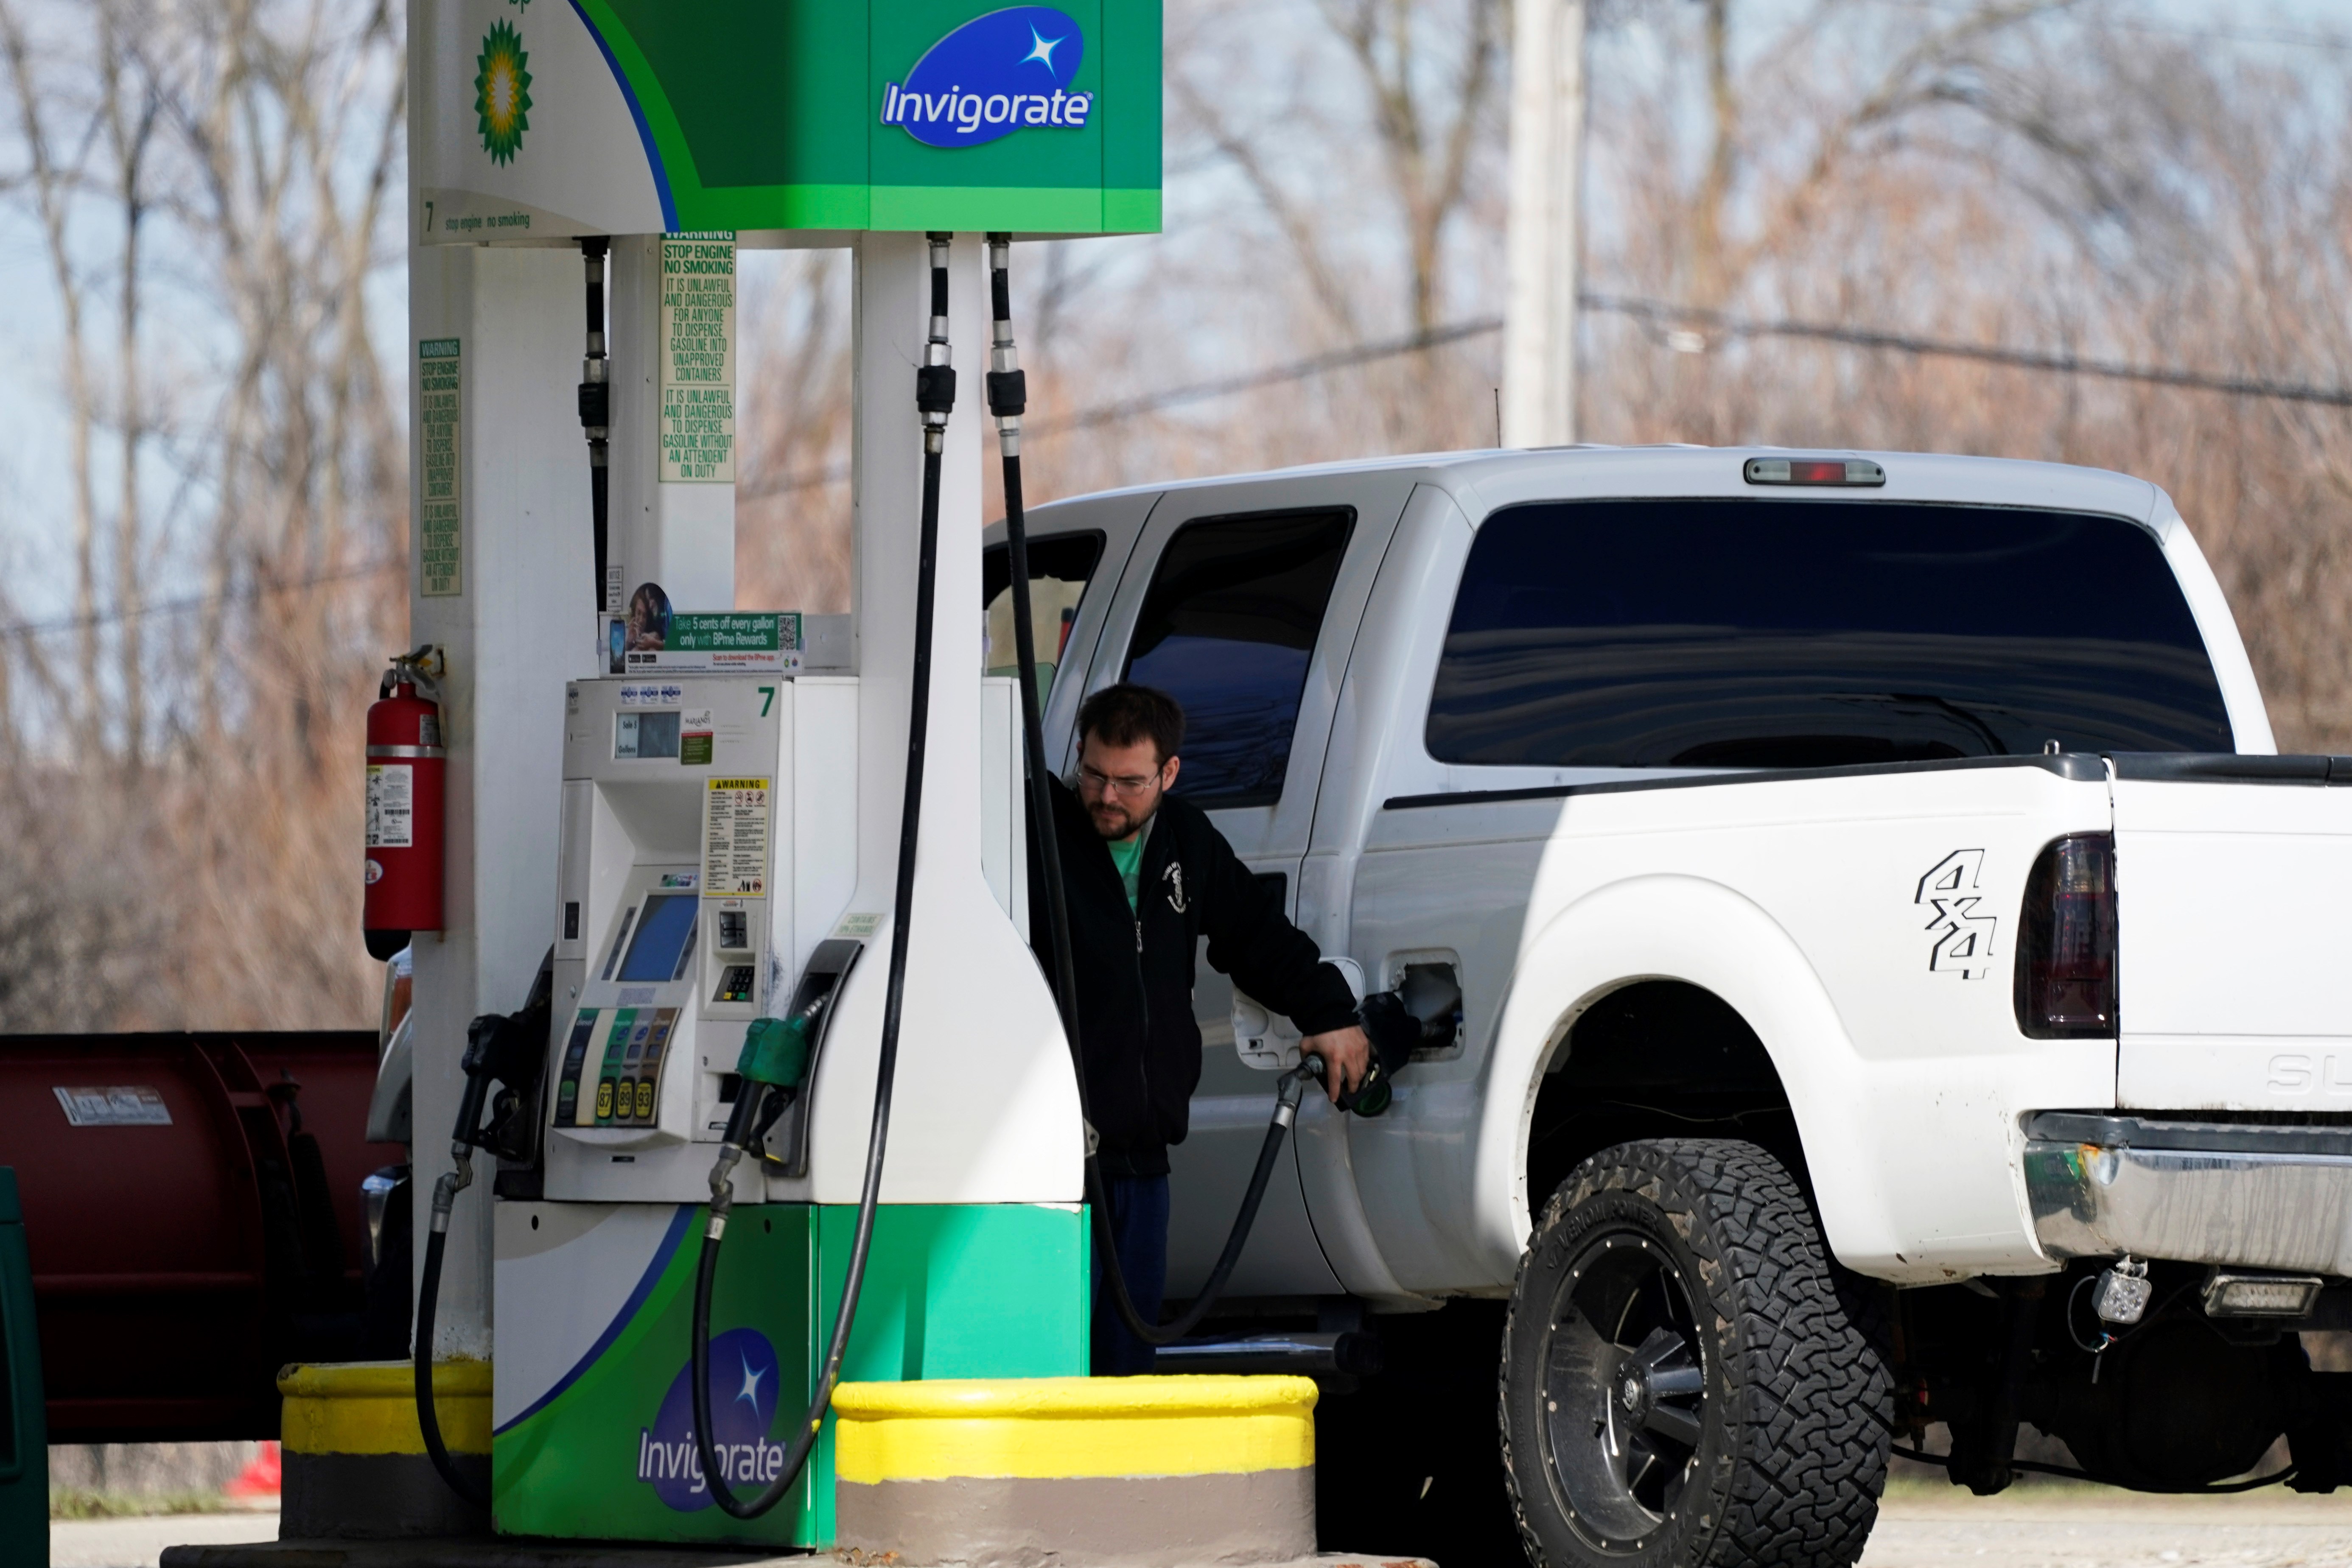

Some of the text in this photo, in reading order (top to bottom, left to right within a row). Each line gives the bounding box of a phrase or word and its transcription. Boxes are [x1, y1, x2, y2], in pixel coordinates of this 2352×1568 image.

[885, 85, 1089, 133] Invigorate
[426, 201, 433, 232] 7
[446, 211, 529, 233] stop engine no smoking
[664, 245, 733, 259] STOP ENGINE
[664, 260, 733, 274] NO SMOKING
[666, 278, 730, 293] IT IS UNLAWFUL
[664, 293, 732, 307] AND DANGEROUS
[674, 308, 724, 322] FOR ANYONE
[672, 323, 723, 337] TO DISPENSE
[422, 341, 458, 356] WARNING
[671, 338, 727, 352] GASOLINE INTO
[673, 352, 724, 366] UNAPPROVED
[676, 367, 721, 381] CONTAINERS
[666, 389, 730, 404] IT IS UNLAWFUL
[664, 405, 732, 419] AND DANGEROUS
[672, 419, 722, 433] TO DISPENSE
[663, 434, 733, 448] GASOLINE WITHOUT
[669, 449, 680, 463] AN
[681, 464, 716, 478] ON DUTY
[675, 617, 691, 630] Take
[693, 617, 698, 630] 5
[699, 618, 719, 629] cents
[720, 616, 730, 629] off
[731, 619, 750, 632] every
[680, 632, 767, 648] only with BPme Rewards
[758, 687, 775, 717] 7
[623, 720, 633, 729] Sale
[619, 745, 636, 754] Gallons
[722, 780, 760, 789] WARNING
[599, 1092, 611, 1107] 87
[619, 1092, 631, 1107] 89
[638, 1092, 650, 1107] 93
